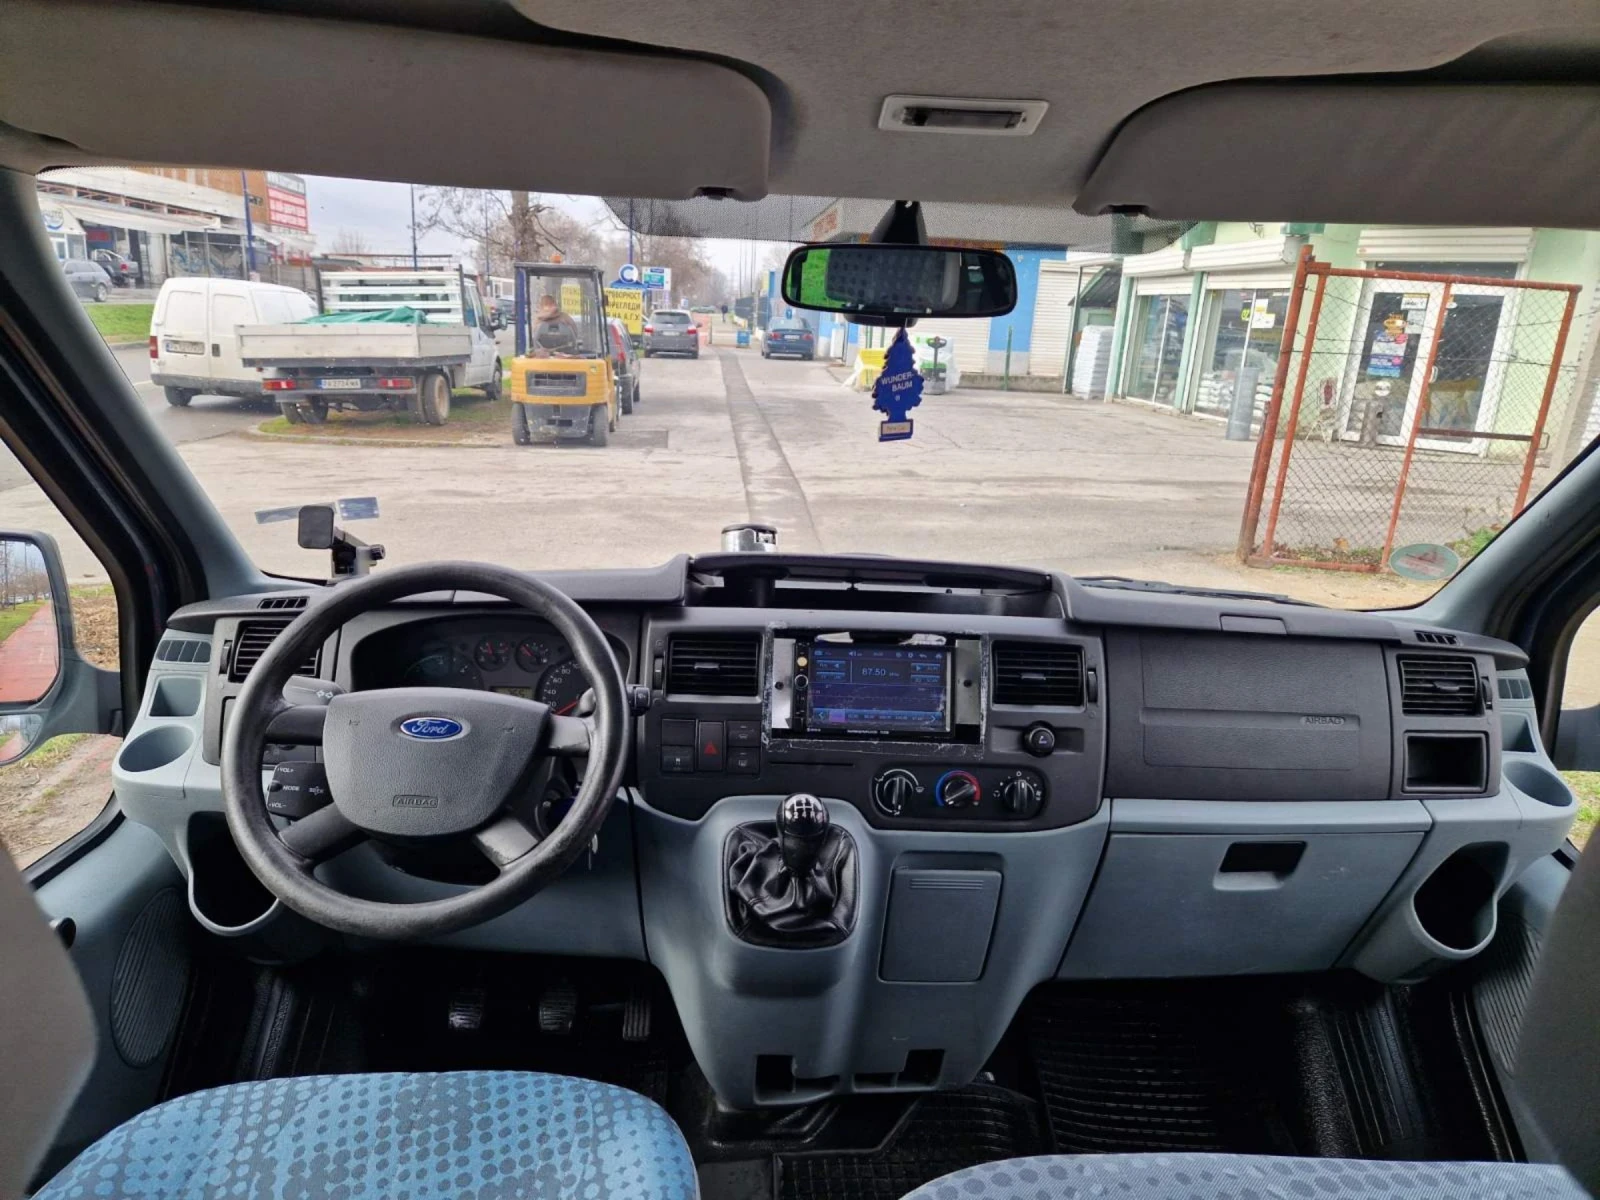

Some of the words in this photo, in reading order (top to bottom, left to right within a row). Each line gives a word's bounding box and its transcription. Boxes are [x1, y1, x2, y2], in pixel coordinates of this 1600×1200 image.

[881, 372, 914, 385] WUNDER-
[892, 381, 913, 392] BAUM
[861, 667, 887, 677] 87.50
[1304, 717, 1343, 725] AIRBAG
[411, 719, 450, 734] Ford
[396, 797, 437, 807] AIRBAG
